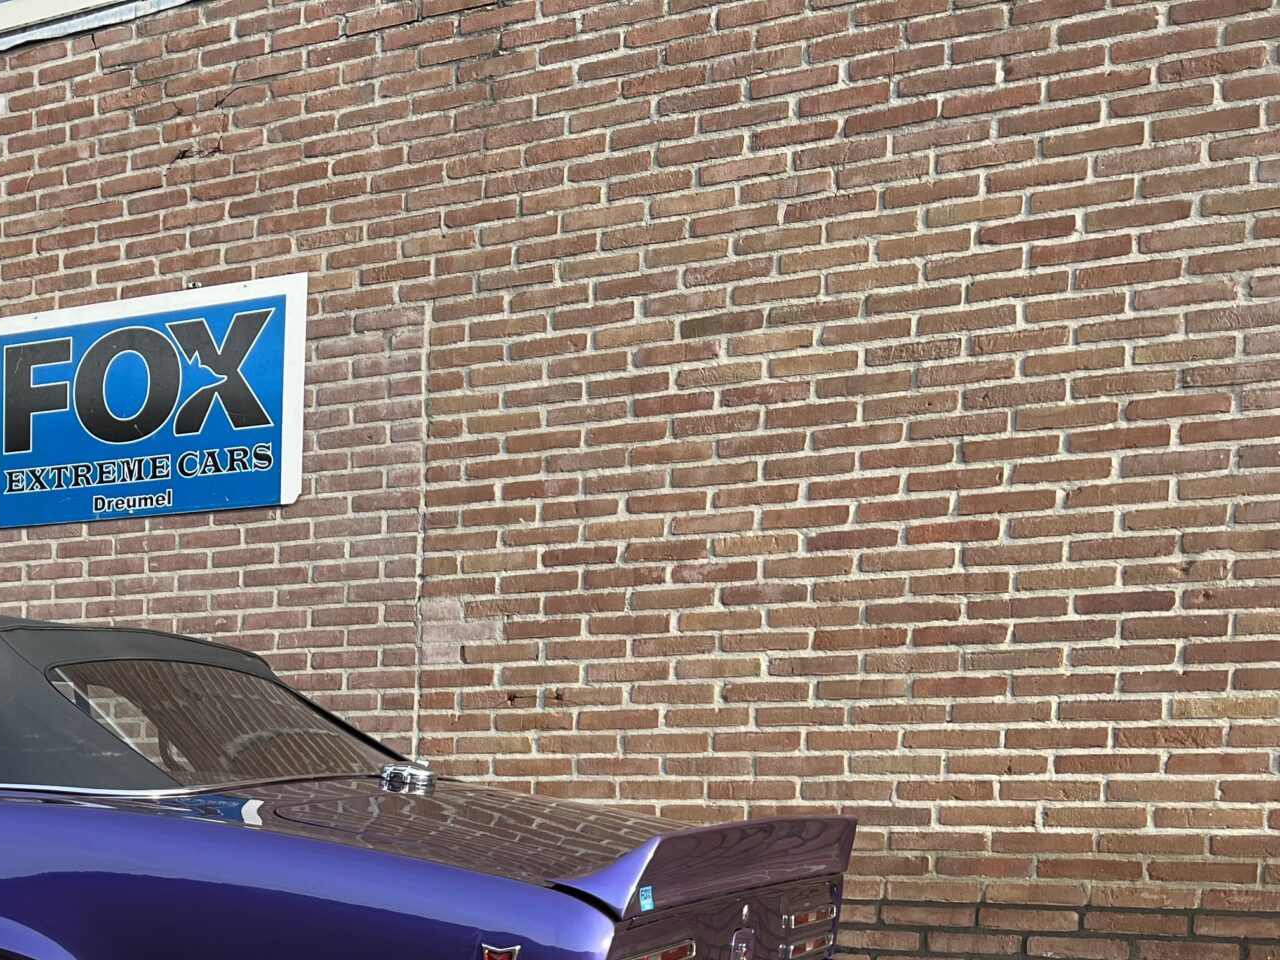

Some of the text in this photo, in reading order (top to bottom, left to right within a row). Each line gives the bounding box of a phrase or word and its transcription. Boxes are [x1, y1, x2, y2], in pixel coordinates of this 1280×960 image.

[3, 307, 276, 455] FOX
[3, 442, 274, 495] EXTREME CARS
[93, 489, 173, 513] Dreumel
